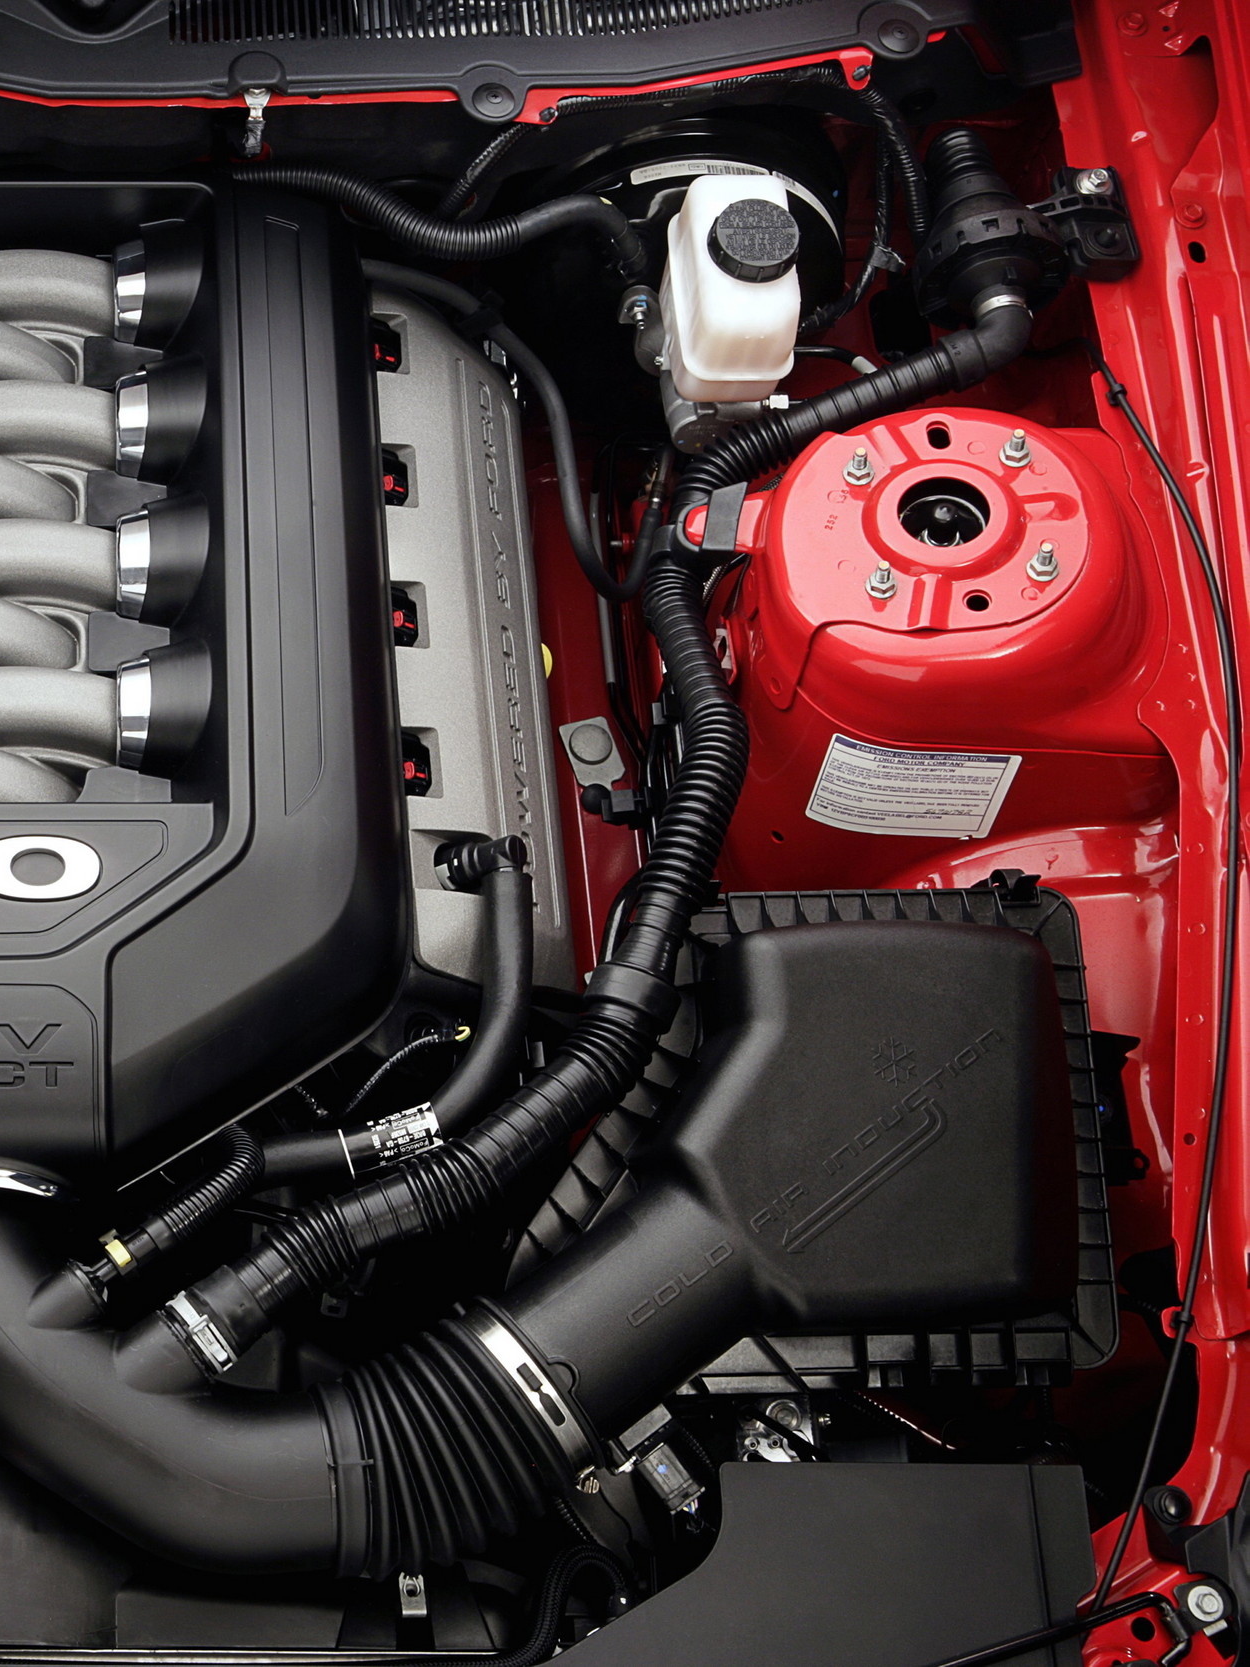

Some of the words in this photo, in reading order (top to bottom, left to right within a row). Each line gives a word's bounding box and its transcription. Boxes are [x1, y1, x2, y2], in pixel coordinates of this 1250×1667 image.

[478, 379, 503, 520] FORD
[491, 531, 510, 609] BY
[501, 624, 540, 912] OWERED
[856, 744, 896, 757] EMISSION
[896, 752, 933, 760] CONTROL
[401, 1140, 428, 1153] FoMoCo
[750, 1182, 809, 1233] AIR
[821, 1028, 1002, 1175] INDUCTION
[627, 1240, 734, 1327] COLD
